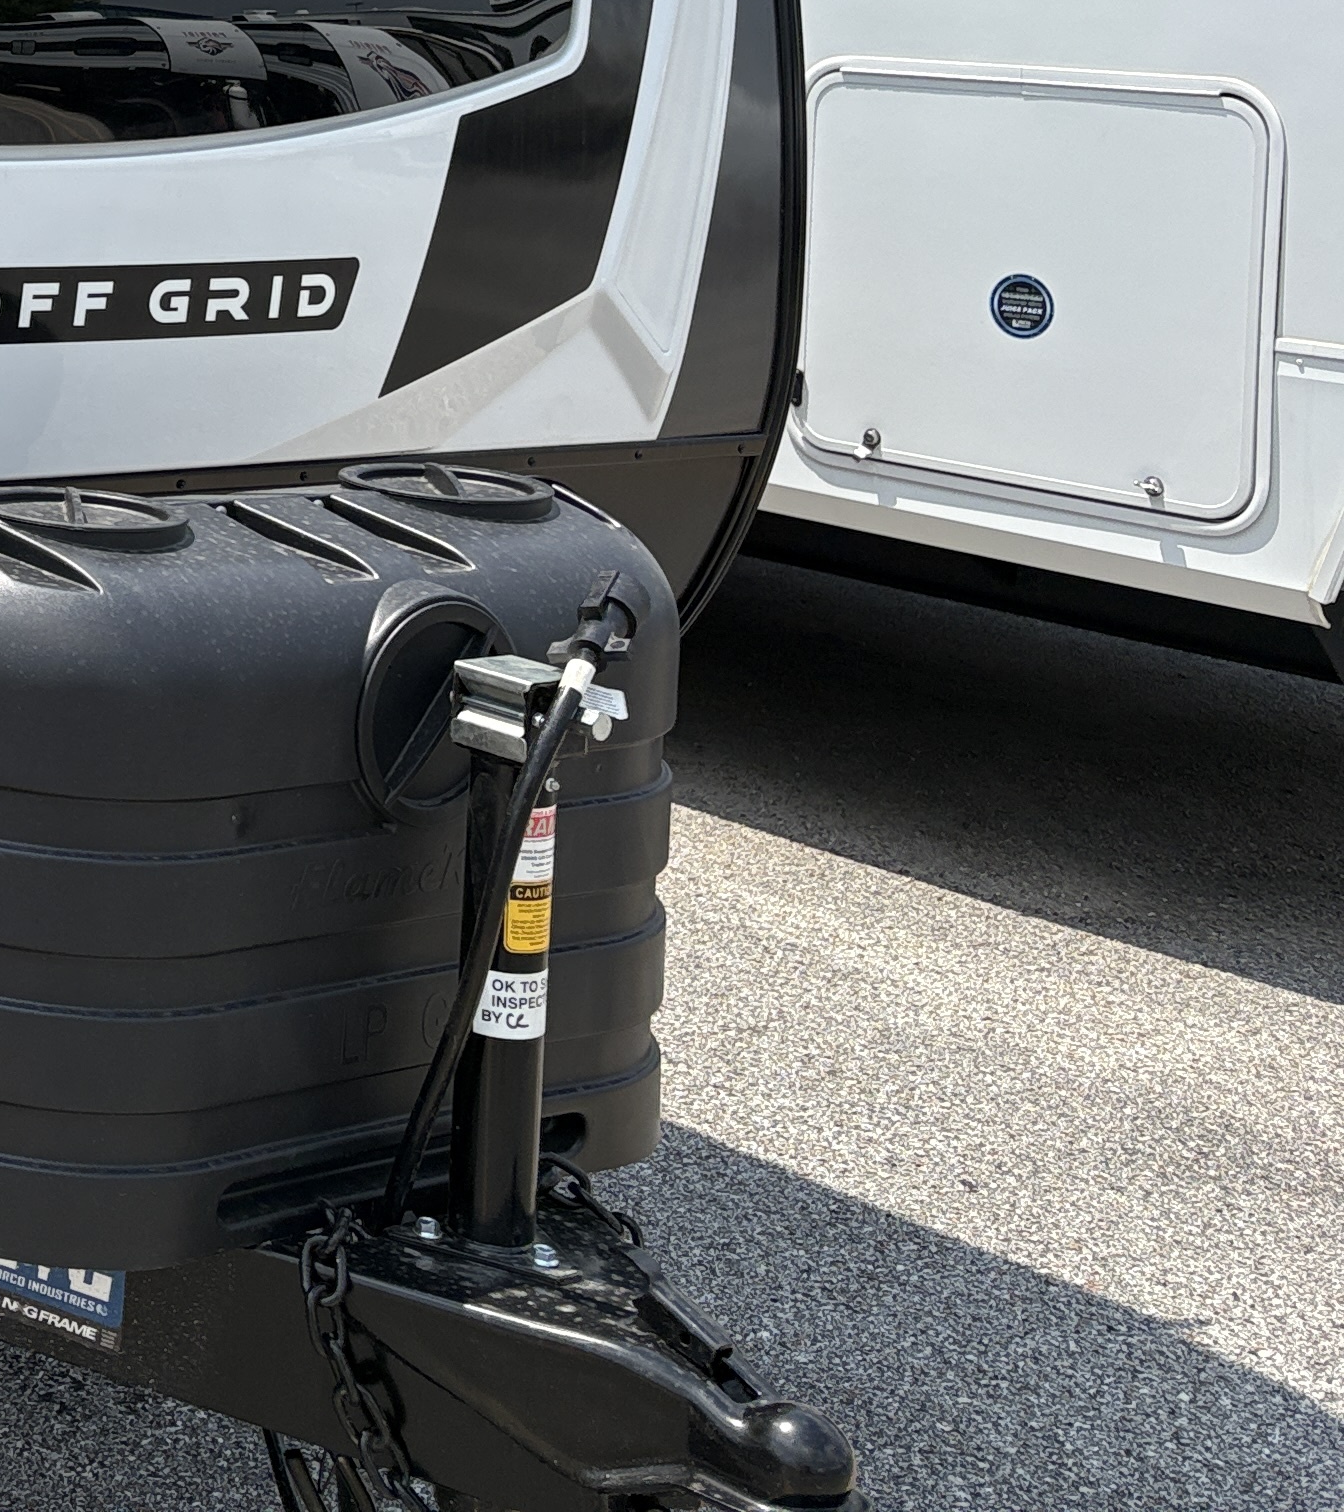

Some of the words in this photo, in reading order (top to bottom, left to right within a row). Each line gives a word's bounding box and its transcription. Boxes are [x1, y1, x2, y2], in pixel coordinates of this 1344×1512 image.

[148, 273, 336, 324] GRID
[492, 979, 516, 993] OK
[520, 981, 538, 993] TO
[482, 1009, 502, 1023] BY
[28, 1279, 96, 1312] INDUSTRIES
[38, 1310, 99, 1342] FRAME
